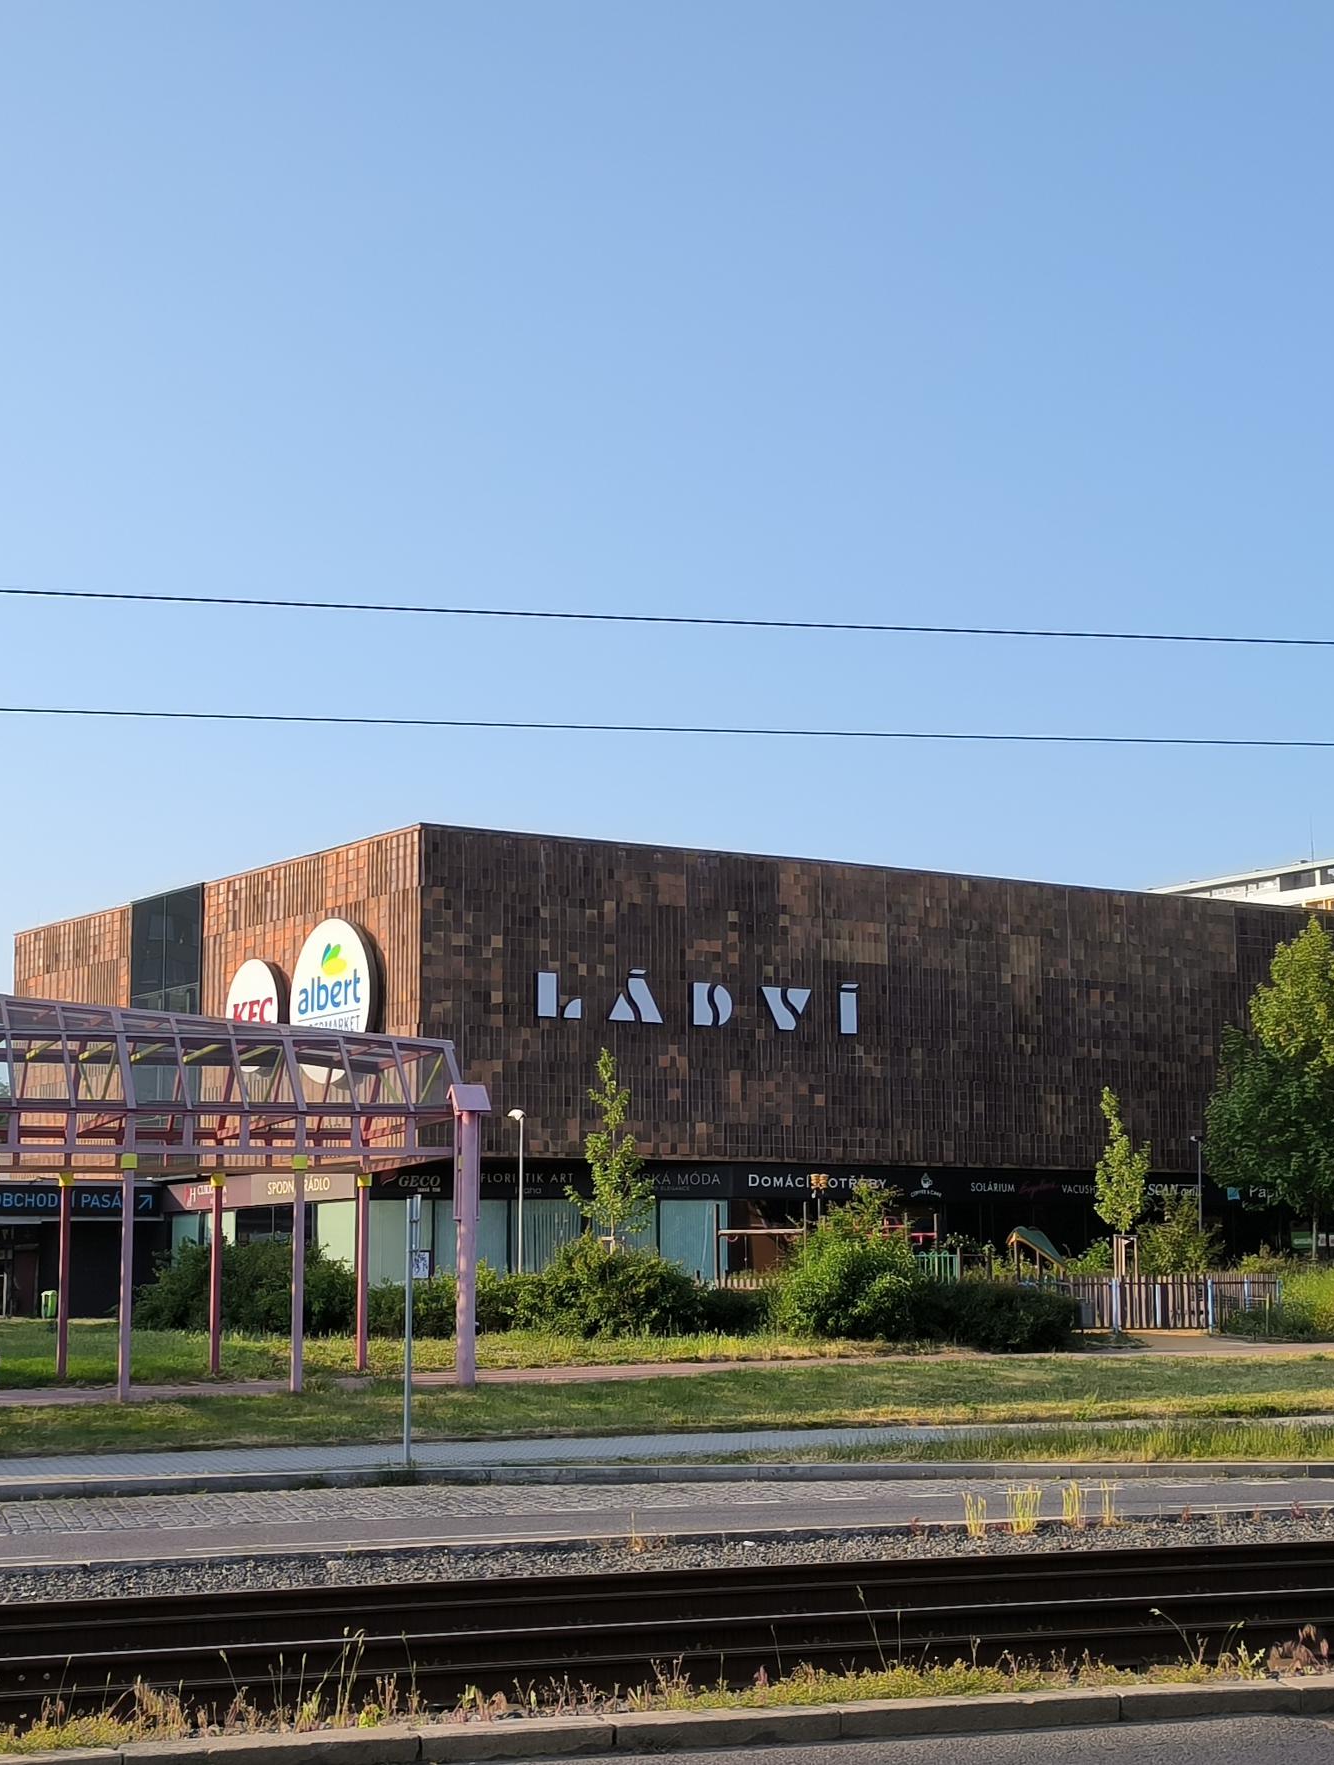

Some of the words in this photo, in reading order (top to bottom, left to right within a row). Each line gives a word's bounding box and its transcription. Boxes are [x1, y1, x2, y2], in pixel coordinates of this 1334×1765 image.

[297, 968, 361, 1015] albert
[534, 967, 860, 1035] LÁDVÍ
[232, 997, 273, 1025] KFC
[267, 1181, 296, 1196] SPODN
[303, 1175, 331, 1192] RÁDLO
[398, 1175, 441, 1188] GECO
[480, 1172, 544, 1184] FLORITIK
[550, 1172, 574, 1183] ART
[677, 1171, 721, 1186] MÓDA
[748, 1173, 810, 1188] DOMÁCÍ
[828, 1175, 887, 1189] OTŘBY
[515, 1186, 542, 1196] aha
[970, 1181, 1015, 1193] SOLÁRIUM
[1061, 1183, 1096, 1195] VACUSH
[1147, 1183, 1178, 1196] SCAN
[81, 1191, 124, 1209] PASÁ
